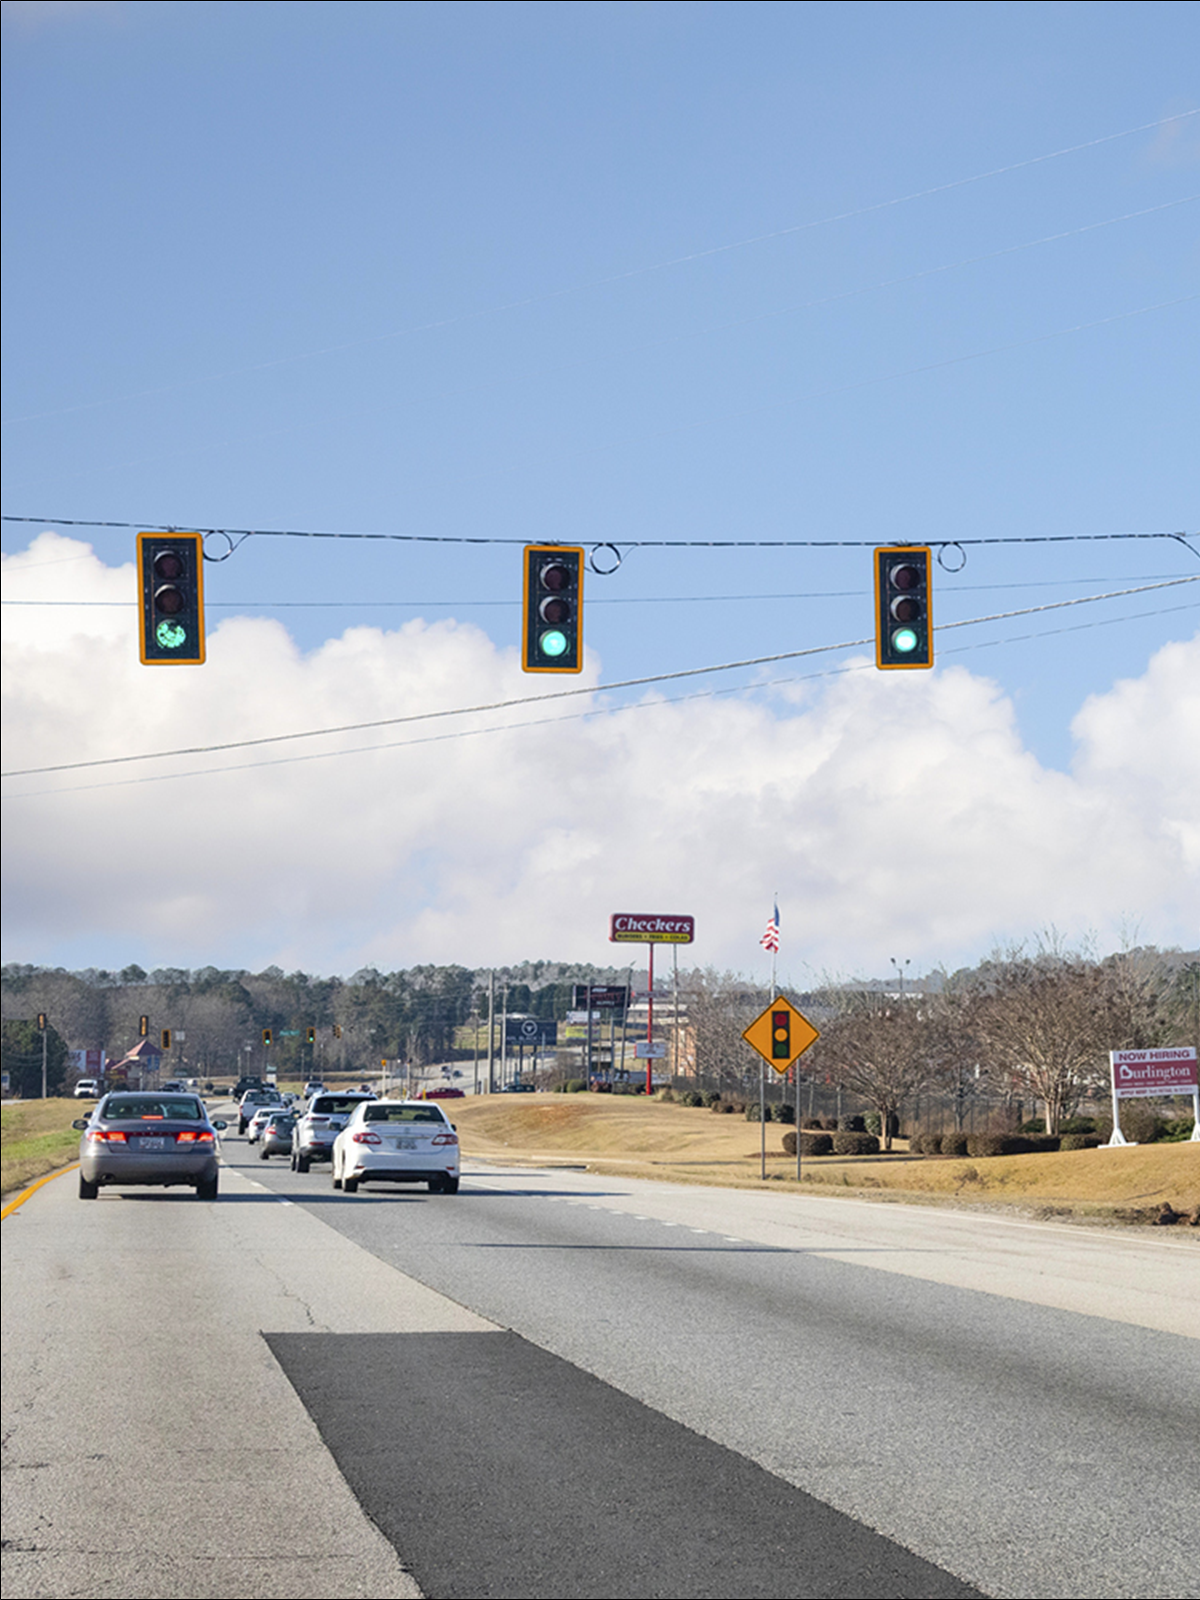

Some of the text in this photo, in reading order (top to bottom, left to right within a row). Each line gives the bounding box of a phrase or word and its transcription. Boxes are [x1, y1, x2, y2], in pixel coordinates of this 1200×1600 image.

[615, 916, 692, 933] Checkers
[1118, 1049, 1191, 1061] NOW HIRING
[1119, 1064, 1191, 1082] Burlington
